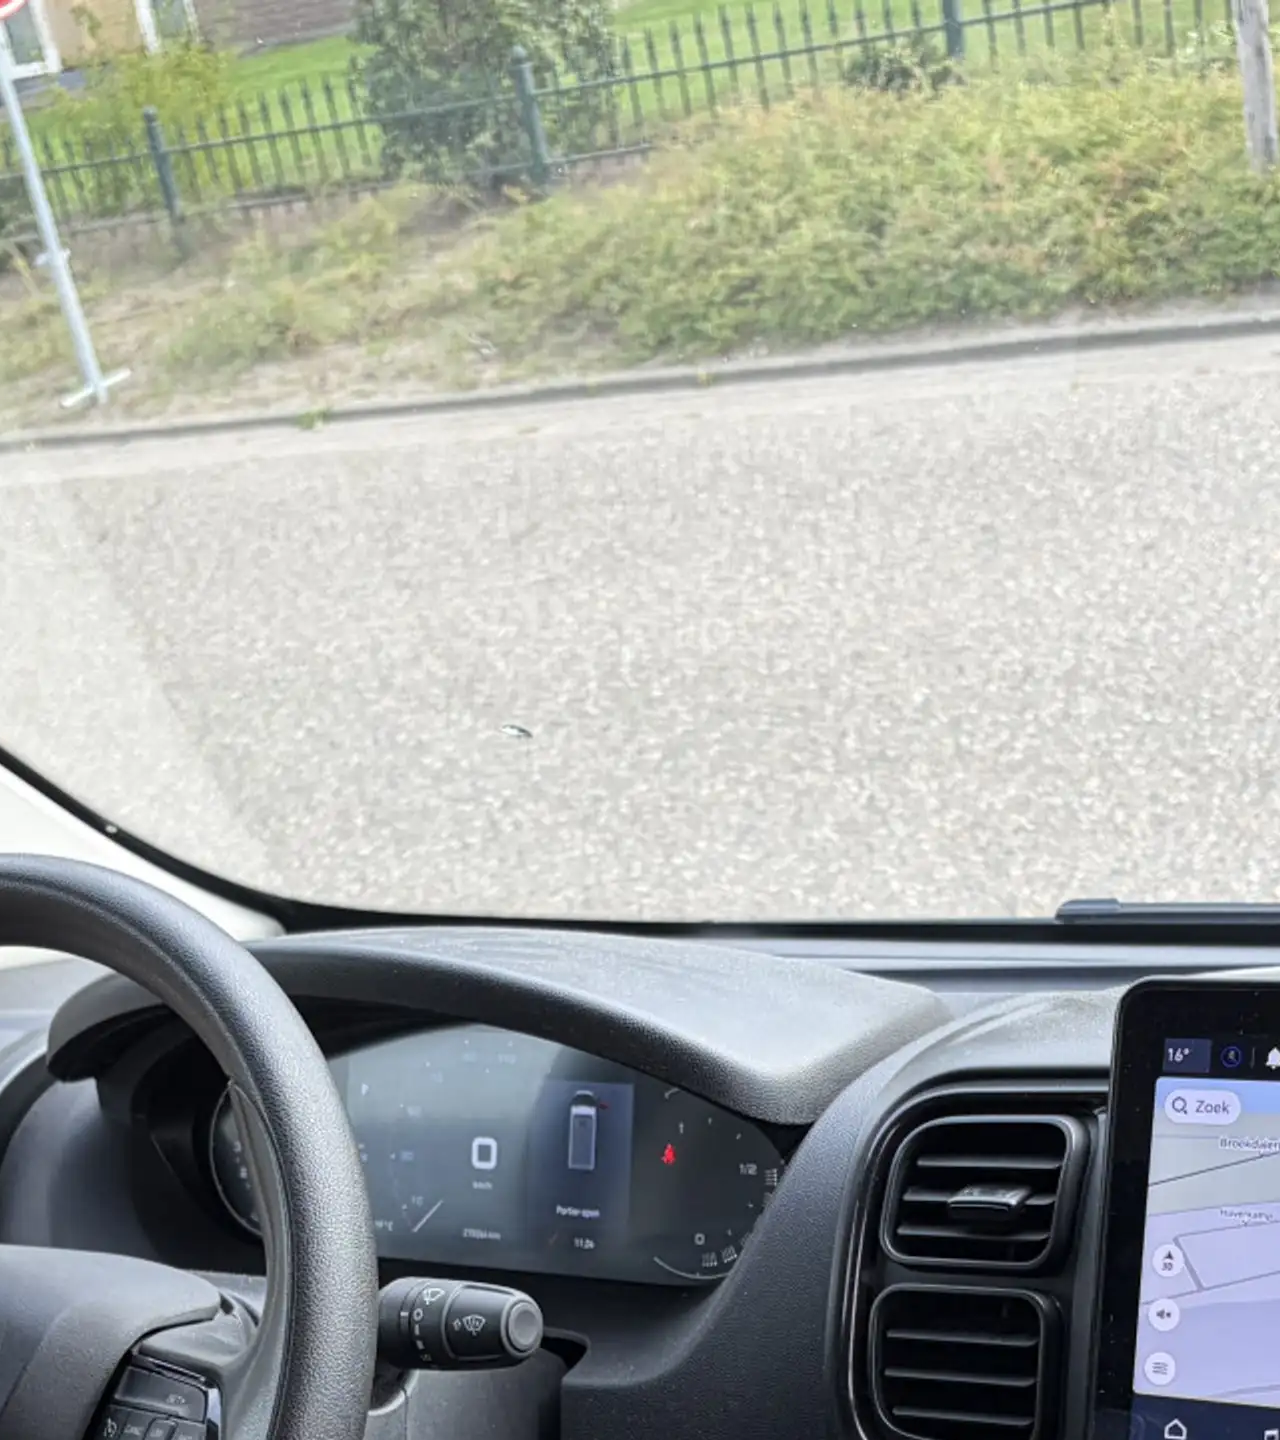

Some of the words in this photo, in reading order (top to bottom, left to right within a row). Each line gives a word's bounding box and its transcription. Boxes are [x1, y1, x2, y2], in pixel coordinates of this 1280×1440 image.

[1167, 1047, 1191, 1063] 16°
[1195, 1100, 1231, 1115] Zoek
[471, 1136, 498, 1170] 0
[739, 1163, 758, 1176] 1/2
